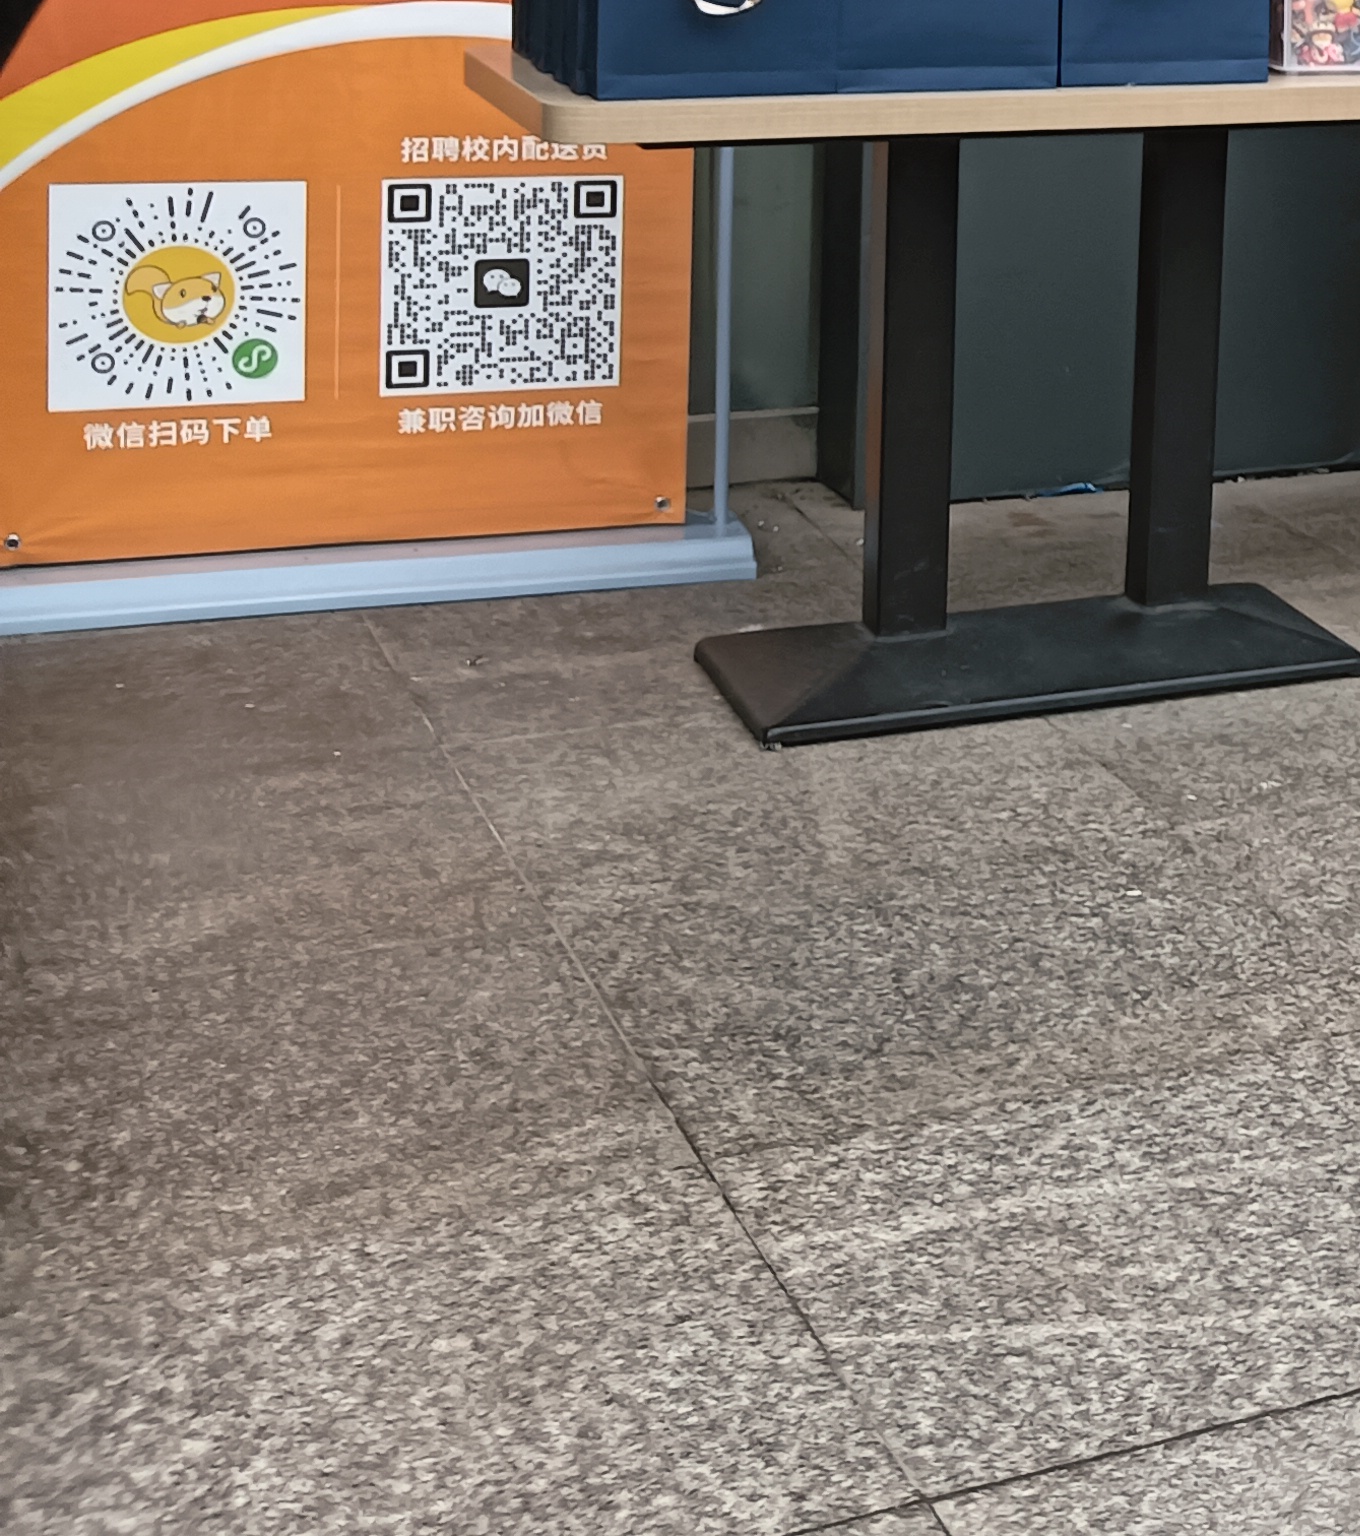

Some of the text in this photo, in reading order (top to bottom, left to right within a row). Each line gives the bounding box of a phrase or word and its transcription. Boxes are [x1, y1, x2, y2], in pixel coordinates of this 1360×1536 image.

[84, 415, 273, 451] 微信扫码下单
[398, 399, 604, 434] 兼职咨询加微信
